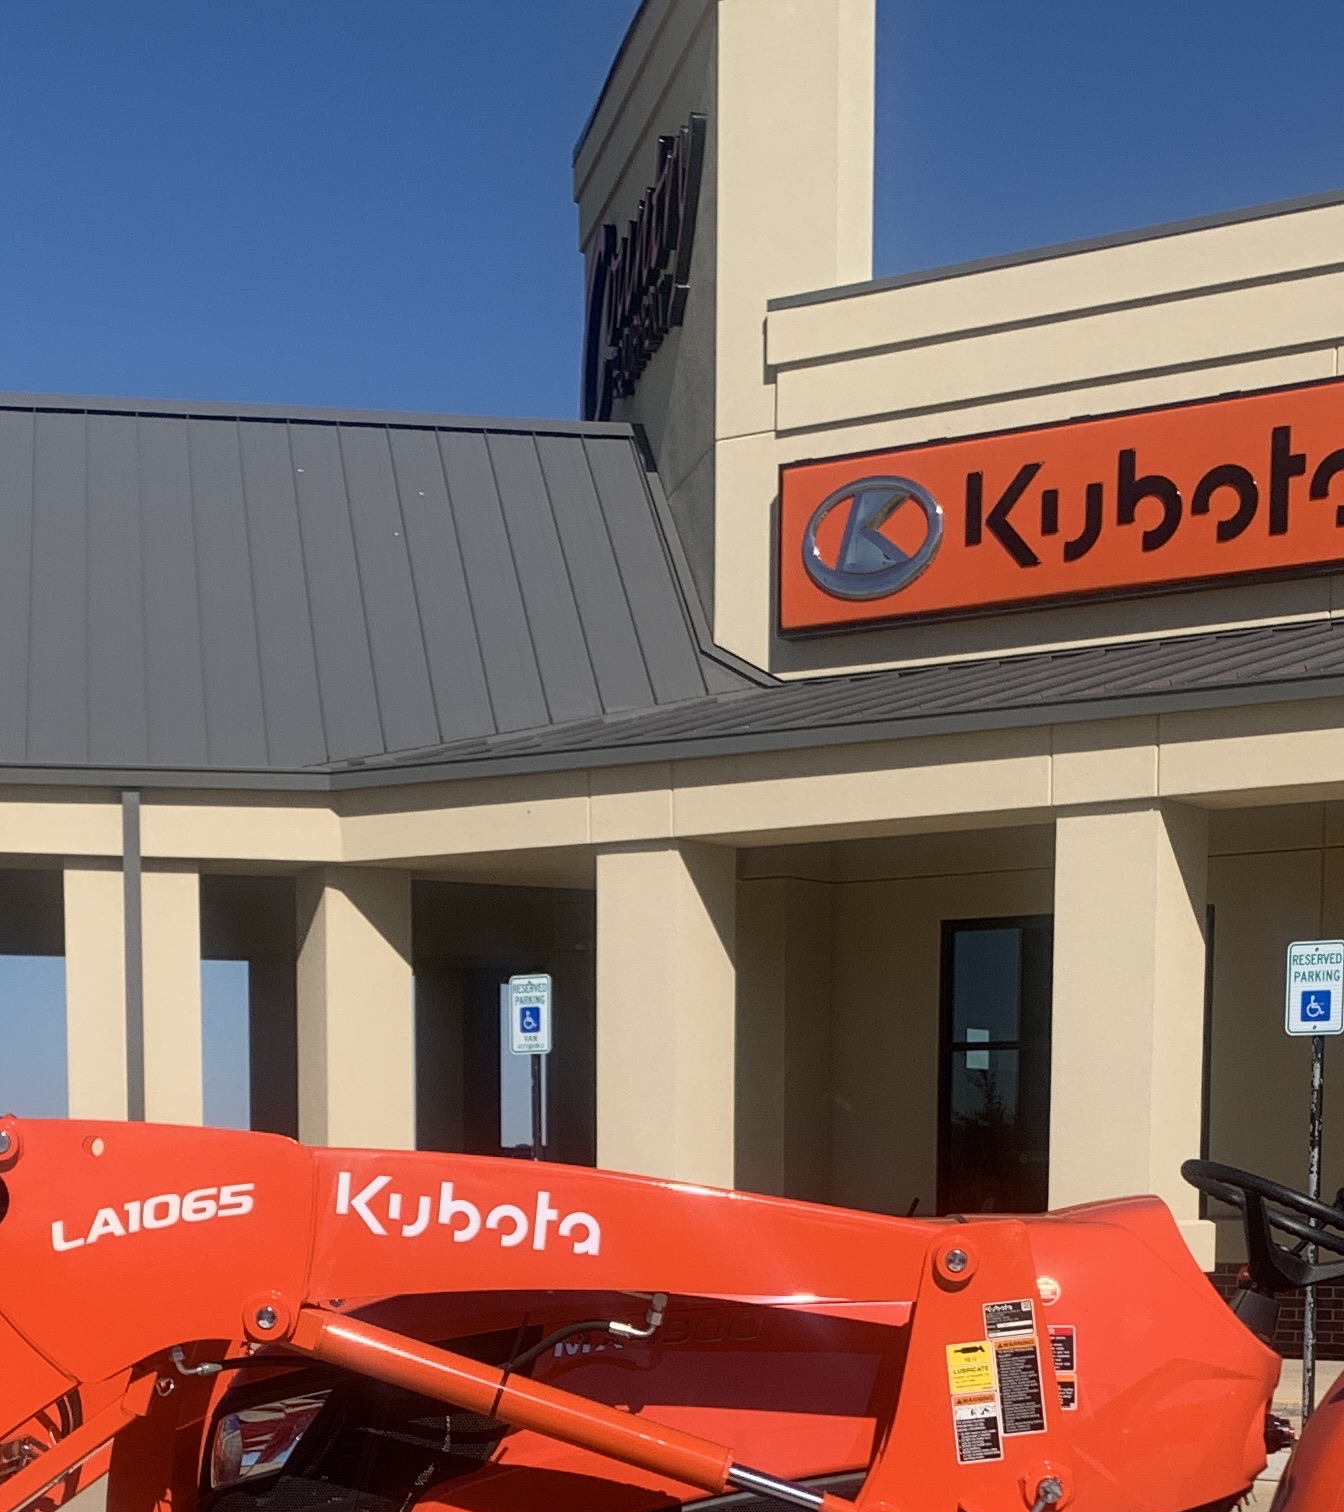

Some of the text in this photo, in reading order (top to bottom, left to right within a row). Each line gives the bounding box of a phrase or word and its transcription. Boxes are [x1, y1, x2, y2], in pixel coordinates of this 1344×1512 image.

[1292, 953, 1342, 966] RESERVED
[1294, 970, 1340, 982] PARKING
[513, 983, 546, 993] RESERVED
[515, 995, 545, 1005] PARKING
[50, 1182, 255, 1252] LA1065
[336, 1171, 600, 1256] Kubota
[953, 1365, 989, 1375] LUBRICATE
